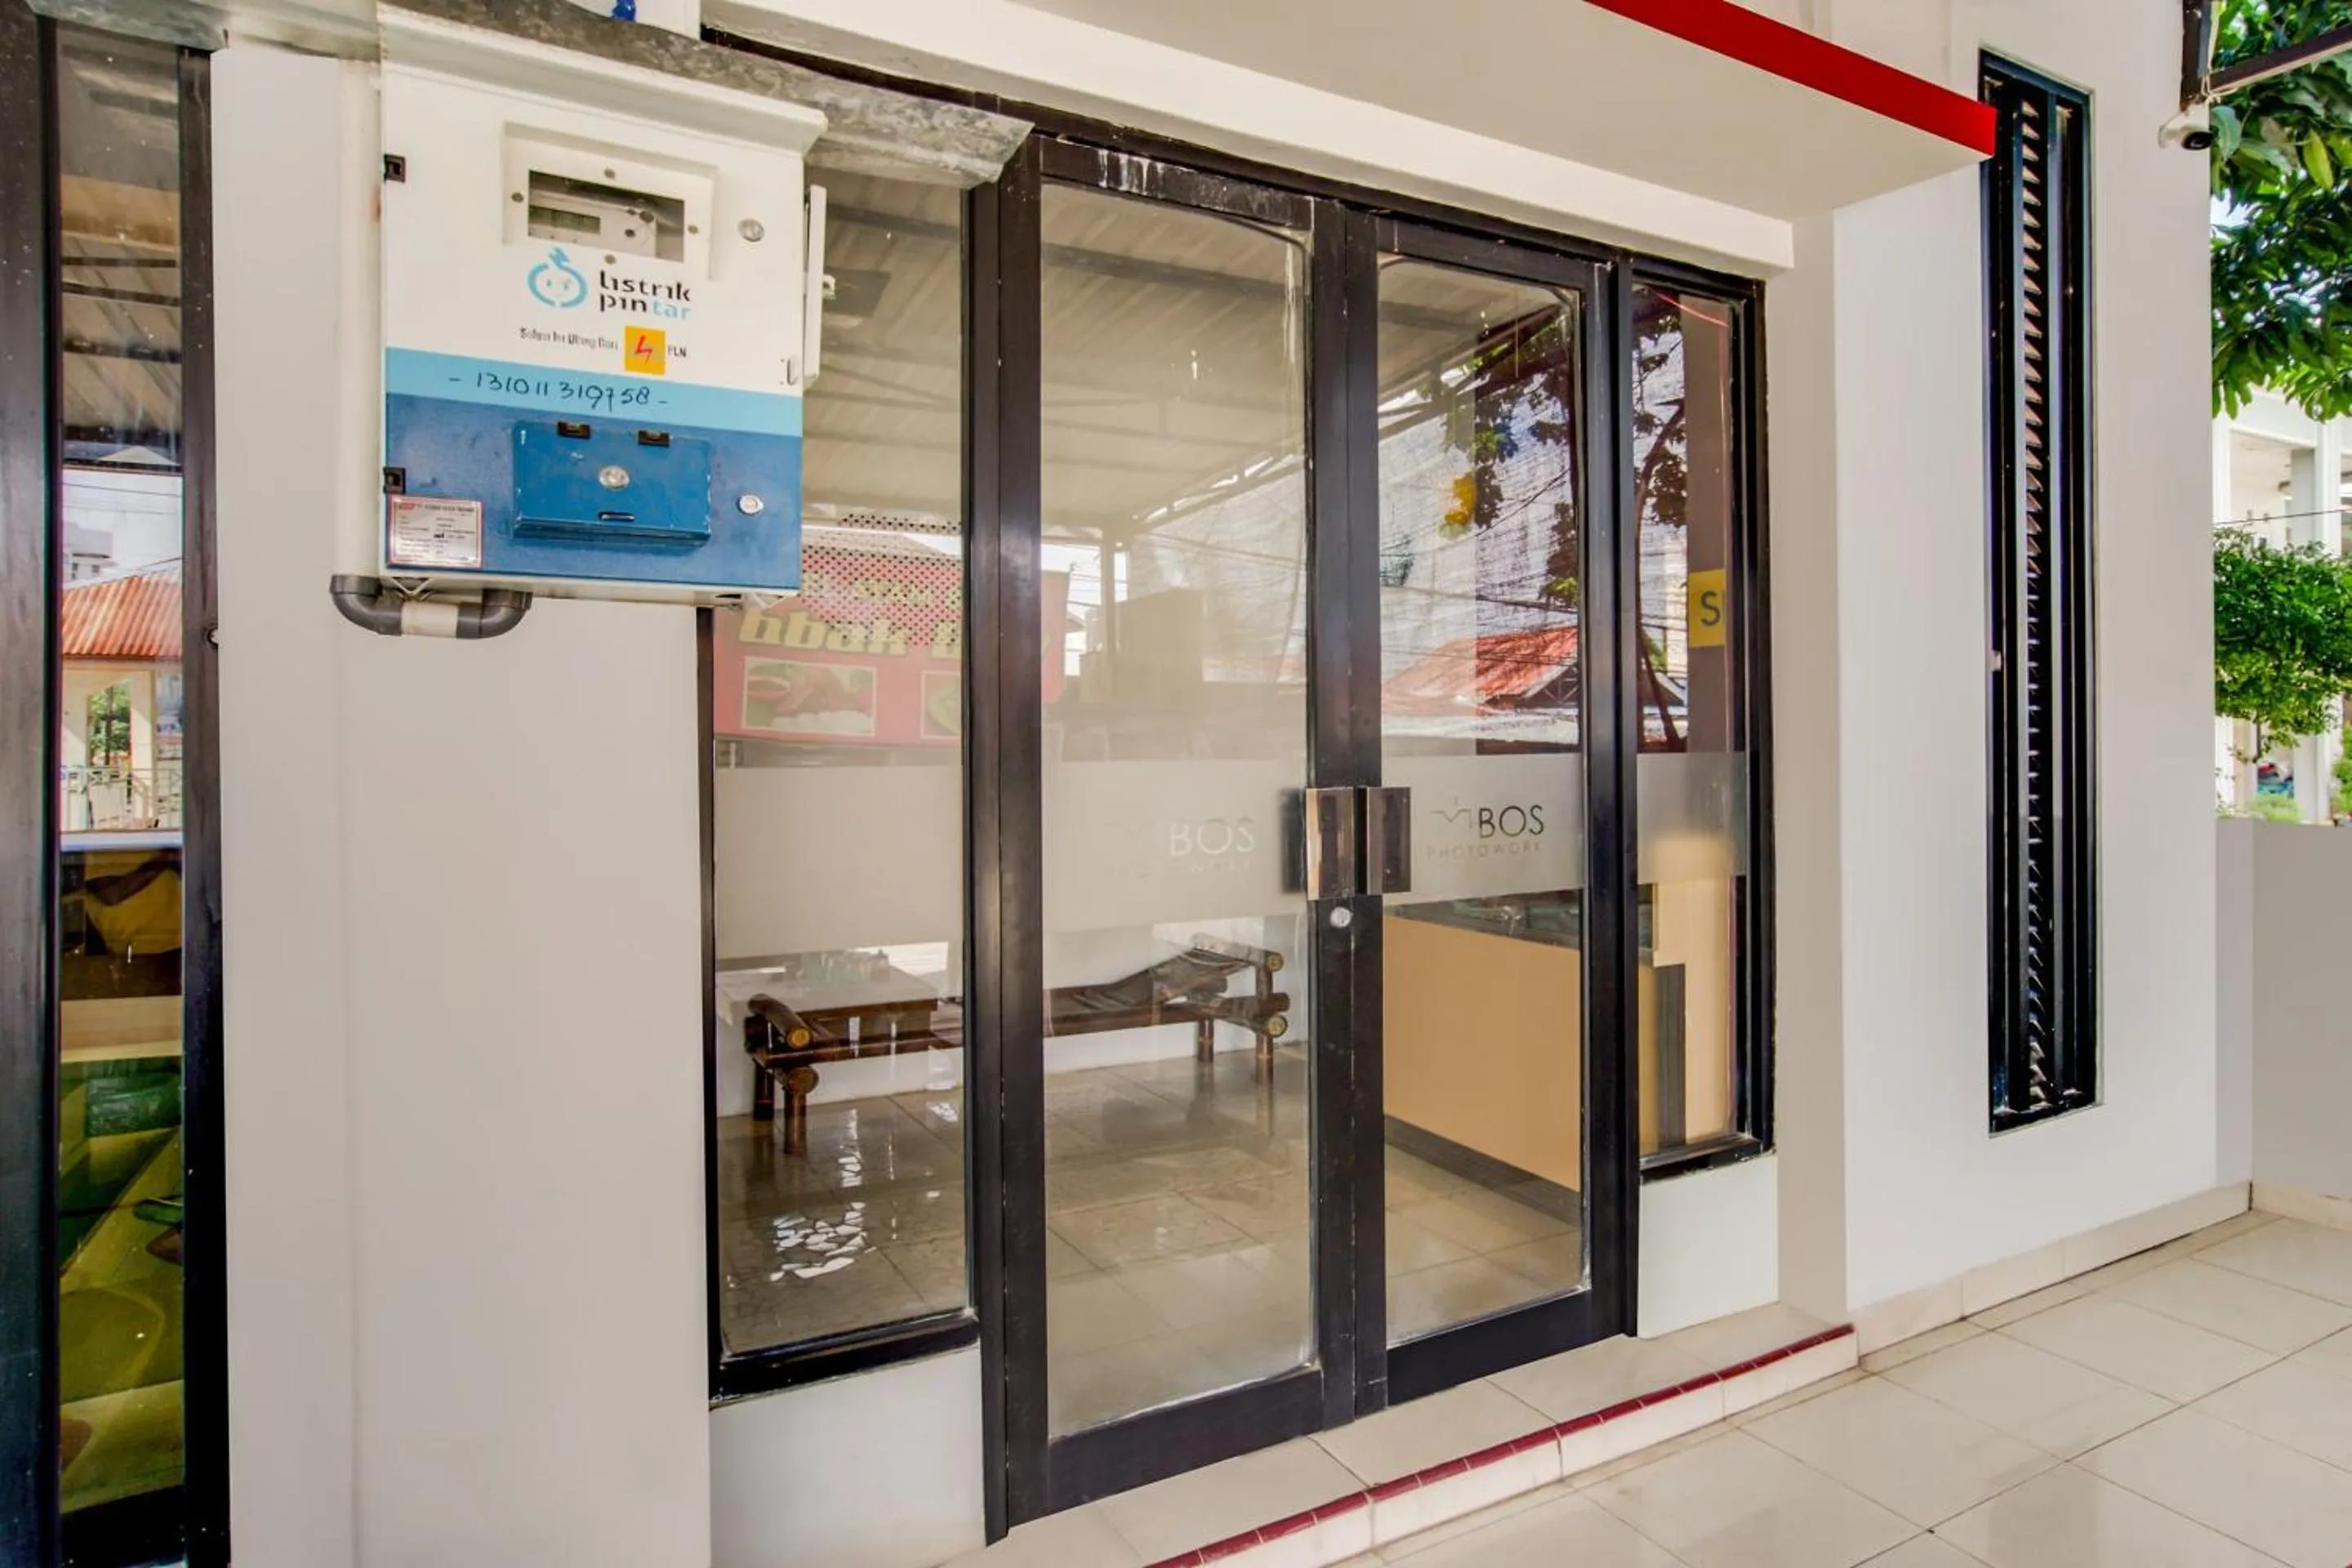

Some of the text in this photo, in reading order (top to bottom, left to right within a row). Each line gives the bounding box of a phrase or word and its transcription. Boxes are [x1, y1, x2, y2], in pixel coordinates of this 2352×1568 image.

[599, 270, 692, 302] listrik
[599, 293, 692, 321] pintar
[667, 345, 687, 359] PLN
[1169, 815, 1256, 857] BOS
[1479, 804, 1544, 839] BOS
